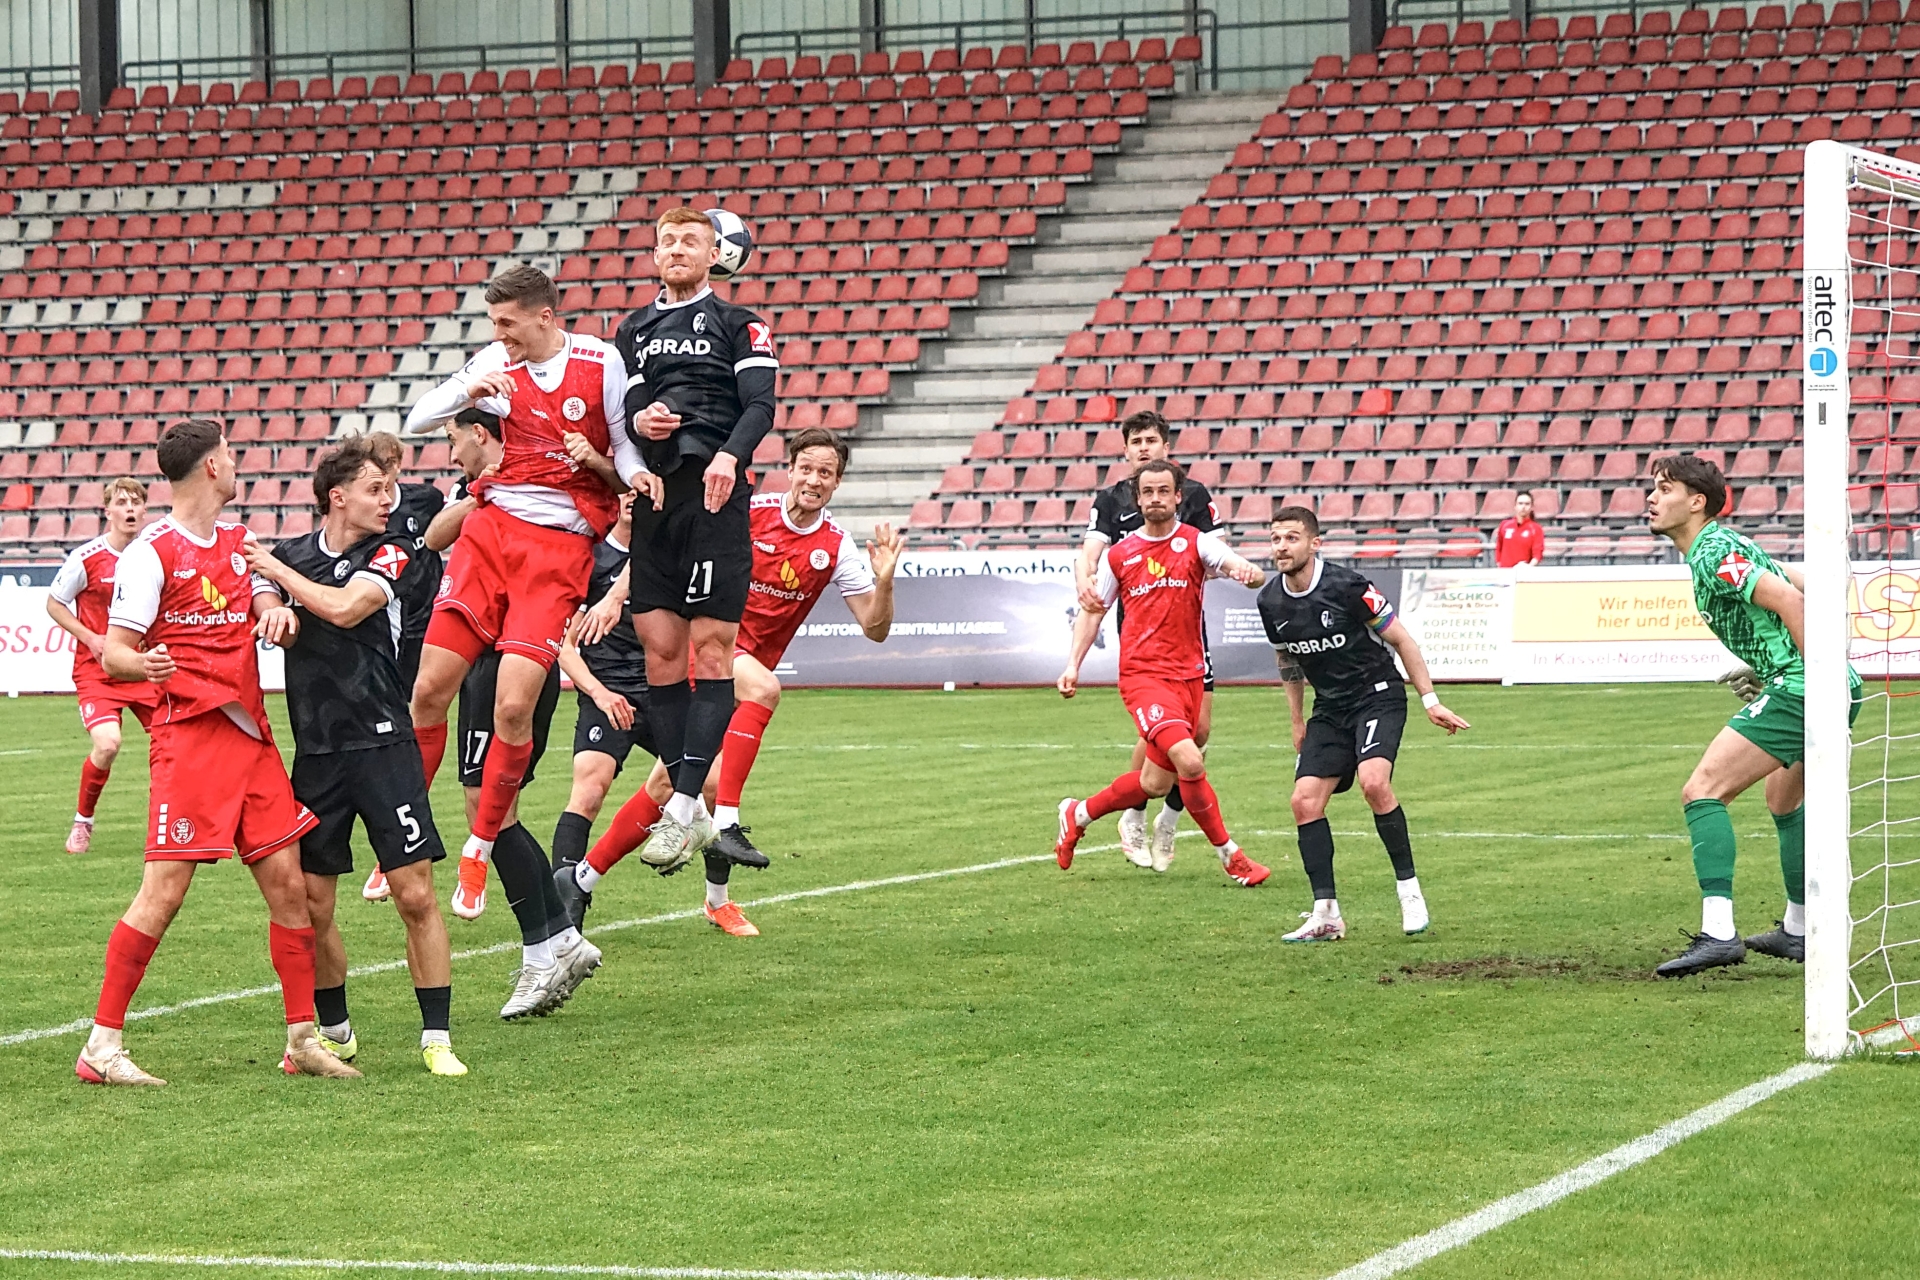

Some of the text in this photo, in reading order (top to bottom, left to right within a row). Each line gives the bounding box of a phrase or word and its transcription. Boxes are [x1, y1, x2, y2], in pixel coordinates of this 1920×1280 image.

[1815, 276, 1837, 343] artec
[1168, 576, 1188, 588] bau
[1599, 596, 1688, 610] Wir helfen
[164, 610, 227, 625] bickhardt
[1423, 619, 1488, 627] KOPIEREN
[1597, 614, 1706, 630] hier und jetz
[1424, 631, 1485, 640] DRUCKEN
[1418, 643, 1498, 652] ESCHRIFTEN
[1426, 657, 1489, 665] ad Arolsen
[1533, 653, 1548, 665] In
[465, 730, 490, 764] 17
[396, 803, 421, 842] 5
